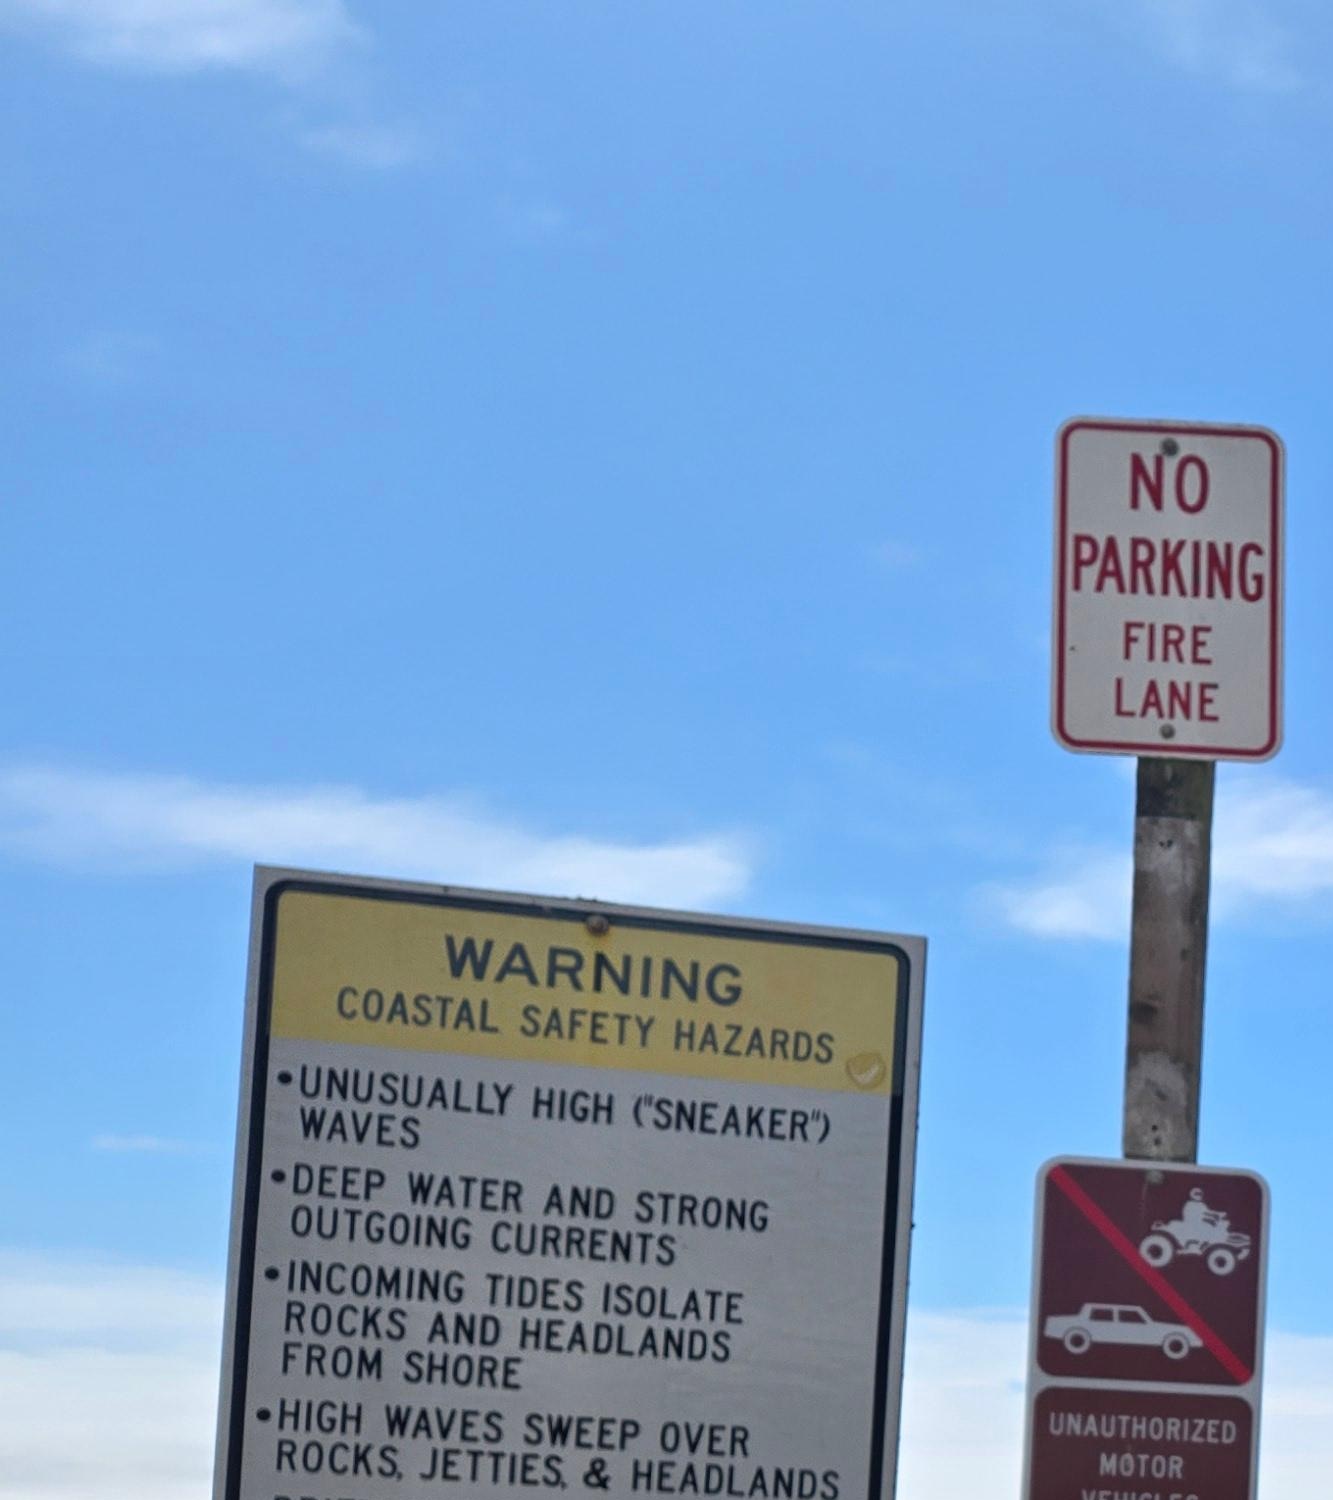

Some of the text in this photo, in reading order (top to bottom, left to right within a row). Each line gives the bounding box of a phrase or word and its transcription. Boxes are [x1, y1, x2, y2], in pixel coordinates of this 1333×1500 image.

[1129, 452, 1210, 515] NO
[1072, 533, 1265, 603] PARKING
[1123, 621, 1213, 665] FIRE
[1114, 676, 1220, 722] LANE
[444, 933, 744, 1006] WARNING
[337, 985, 836, 1065] COASTAL SAFETY HAZARDS
[299, 1065, 514, 1117] UNUSUALLY
[531, 1088, 615, 1126] HIGH
[300, 1106, 421, 1150] WAVES
[292, 1162, 770, 1234] DEEP WATER AND STRONG
[291, 1204, 678, 1267] OUTGOING CURRENTS
[287, 1260, 745, 1325] INCOMING TIDES ISOLATE
[284, 1301, 732, 1363] ROCKS AND HEADLANDS
[281, 1342, 522, 1391] FROM SHORE
[277, 1398, 750, 1459] HIGH WAVES SWEEP OVER
[1049, 1411, 1237, 1445] UNAUTHORIZED
[275, 1440, 403, 1482] ROCKS,
[420, 1447, 567, 1491] JETTIES,
[582, 1457, 612, 1490] &
[1099, 1453, 1184, 1480] MOTOR
